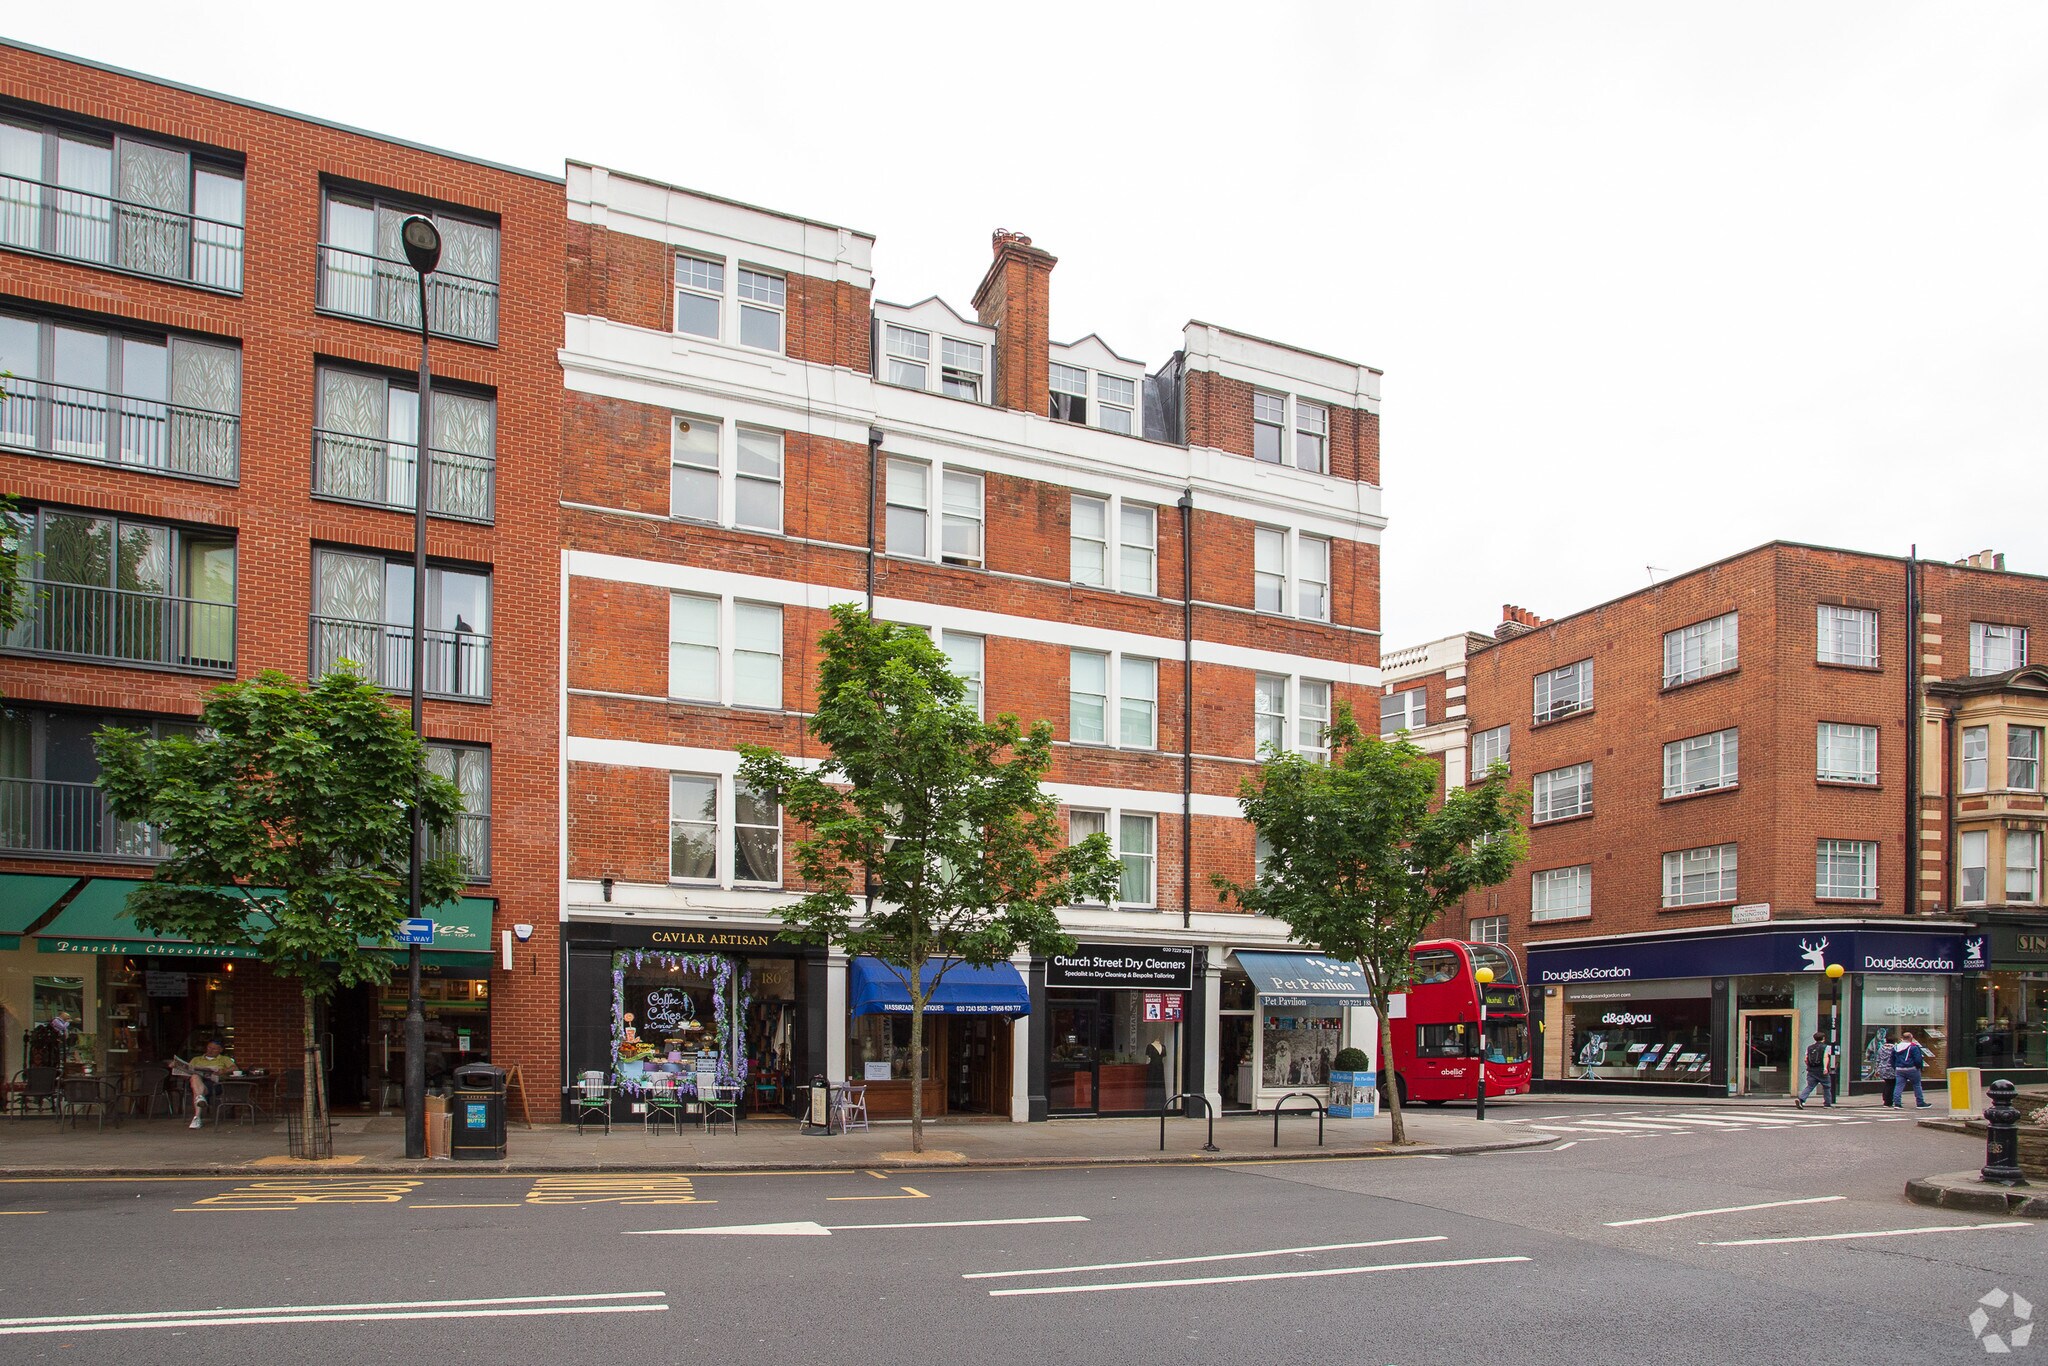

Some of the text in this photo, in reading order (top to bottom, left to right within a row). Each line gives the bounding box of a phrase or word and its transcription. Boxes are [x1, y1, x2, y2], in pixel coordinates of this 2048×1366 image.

[652, 931, 769, 946] CAVIAR ARTISAN
[57, 941, 235, 956] Panache Chocolates
[1054, 955, 1186, 970] Church Street Dry Cleaners
[1864, 956, 1954, 970] Douglas&Gordon
[762, 972, 781, 984] 180
[1064, 970, 1089, 978] Specialist
[1095, 971, 1105, 979] Dry
[1105, 971, 1127, 979] Cleaning
[1133, 972, 1154, 980] Bespoke
[1542, 966, 1631, 981] Douglas&Gordon
[1270, 977, 1357, 991] Pet Pavilion
[1264, 996, 1277, 1006] Pet
[1278, 996, 1307, 1006] Pavilion
[647, 1006, 681, 1024] Cakes
[1601, 1012, 1652, 1025] d&g&you
